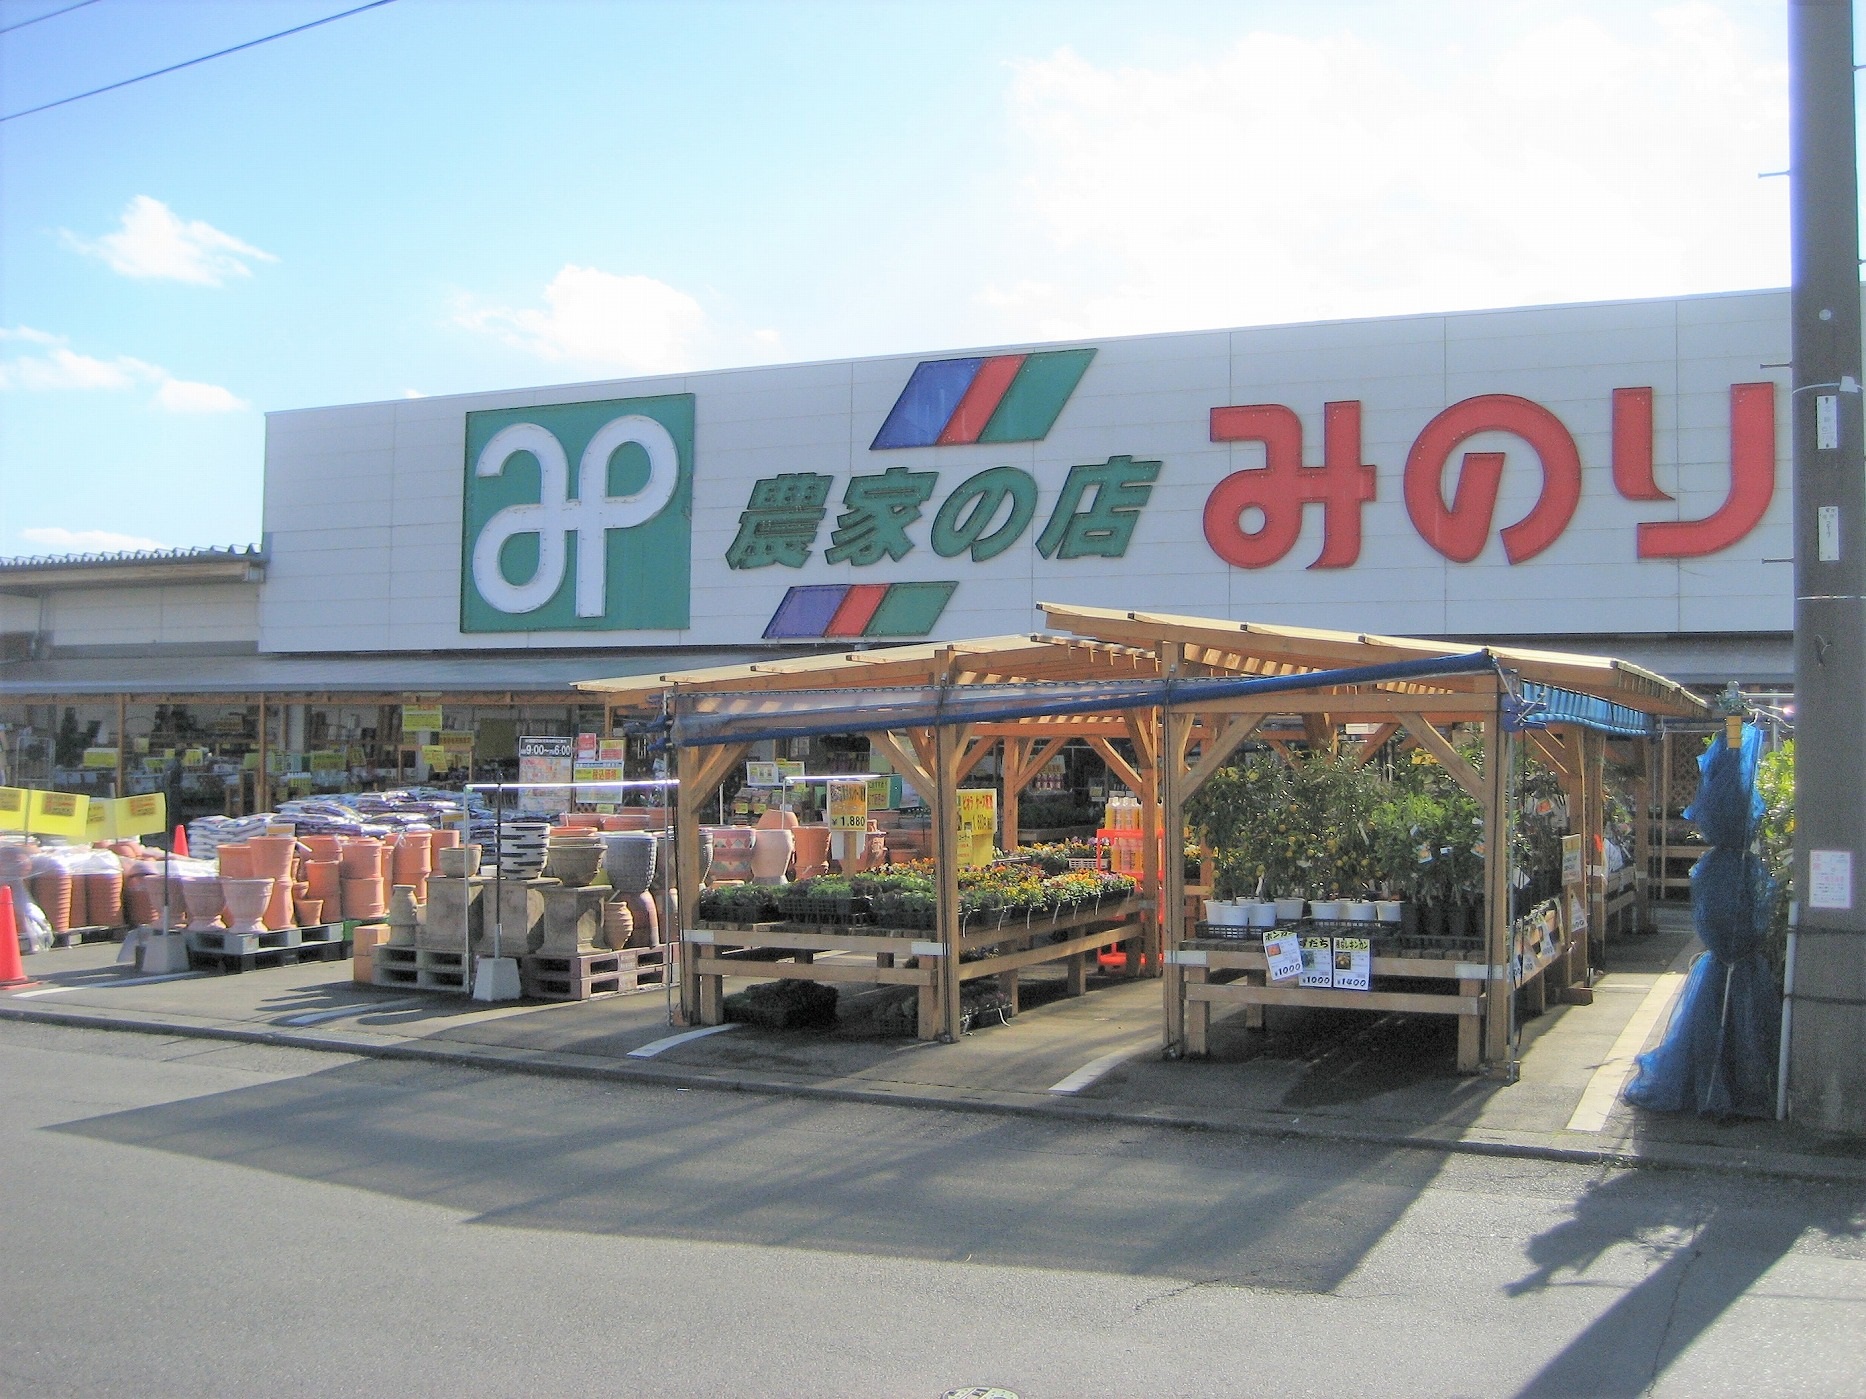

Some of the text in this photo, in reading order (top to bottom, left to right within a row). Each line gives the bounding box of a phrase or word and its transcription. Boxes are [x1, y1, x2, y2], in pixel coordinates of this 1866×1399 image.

[724, 454, 1163, 571] 農家の店
[1202, 381, 1775, 570] みのり
